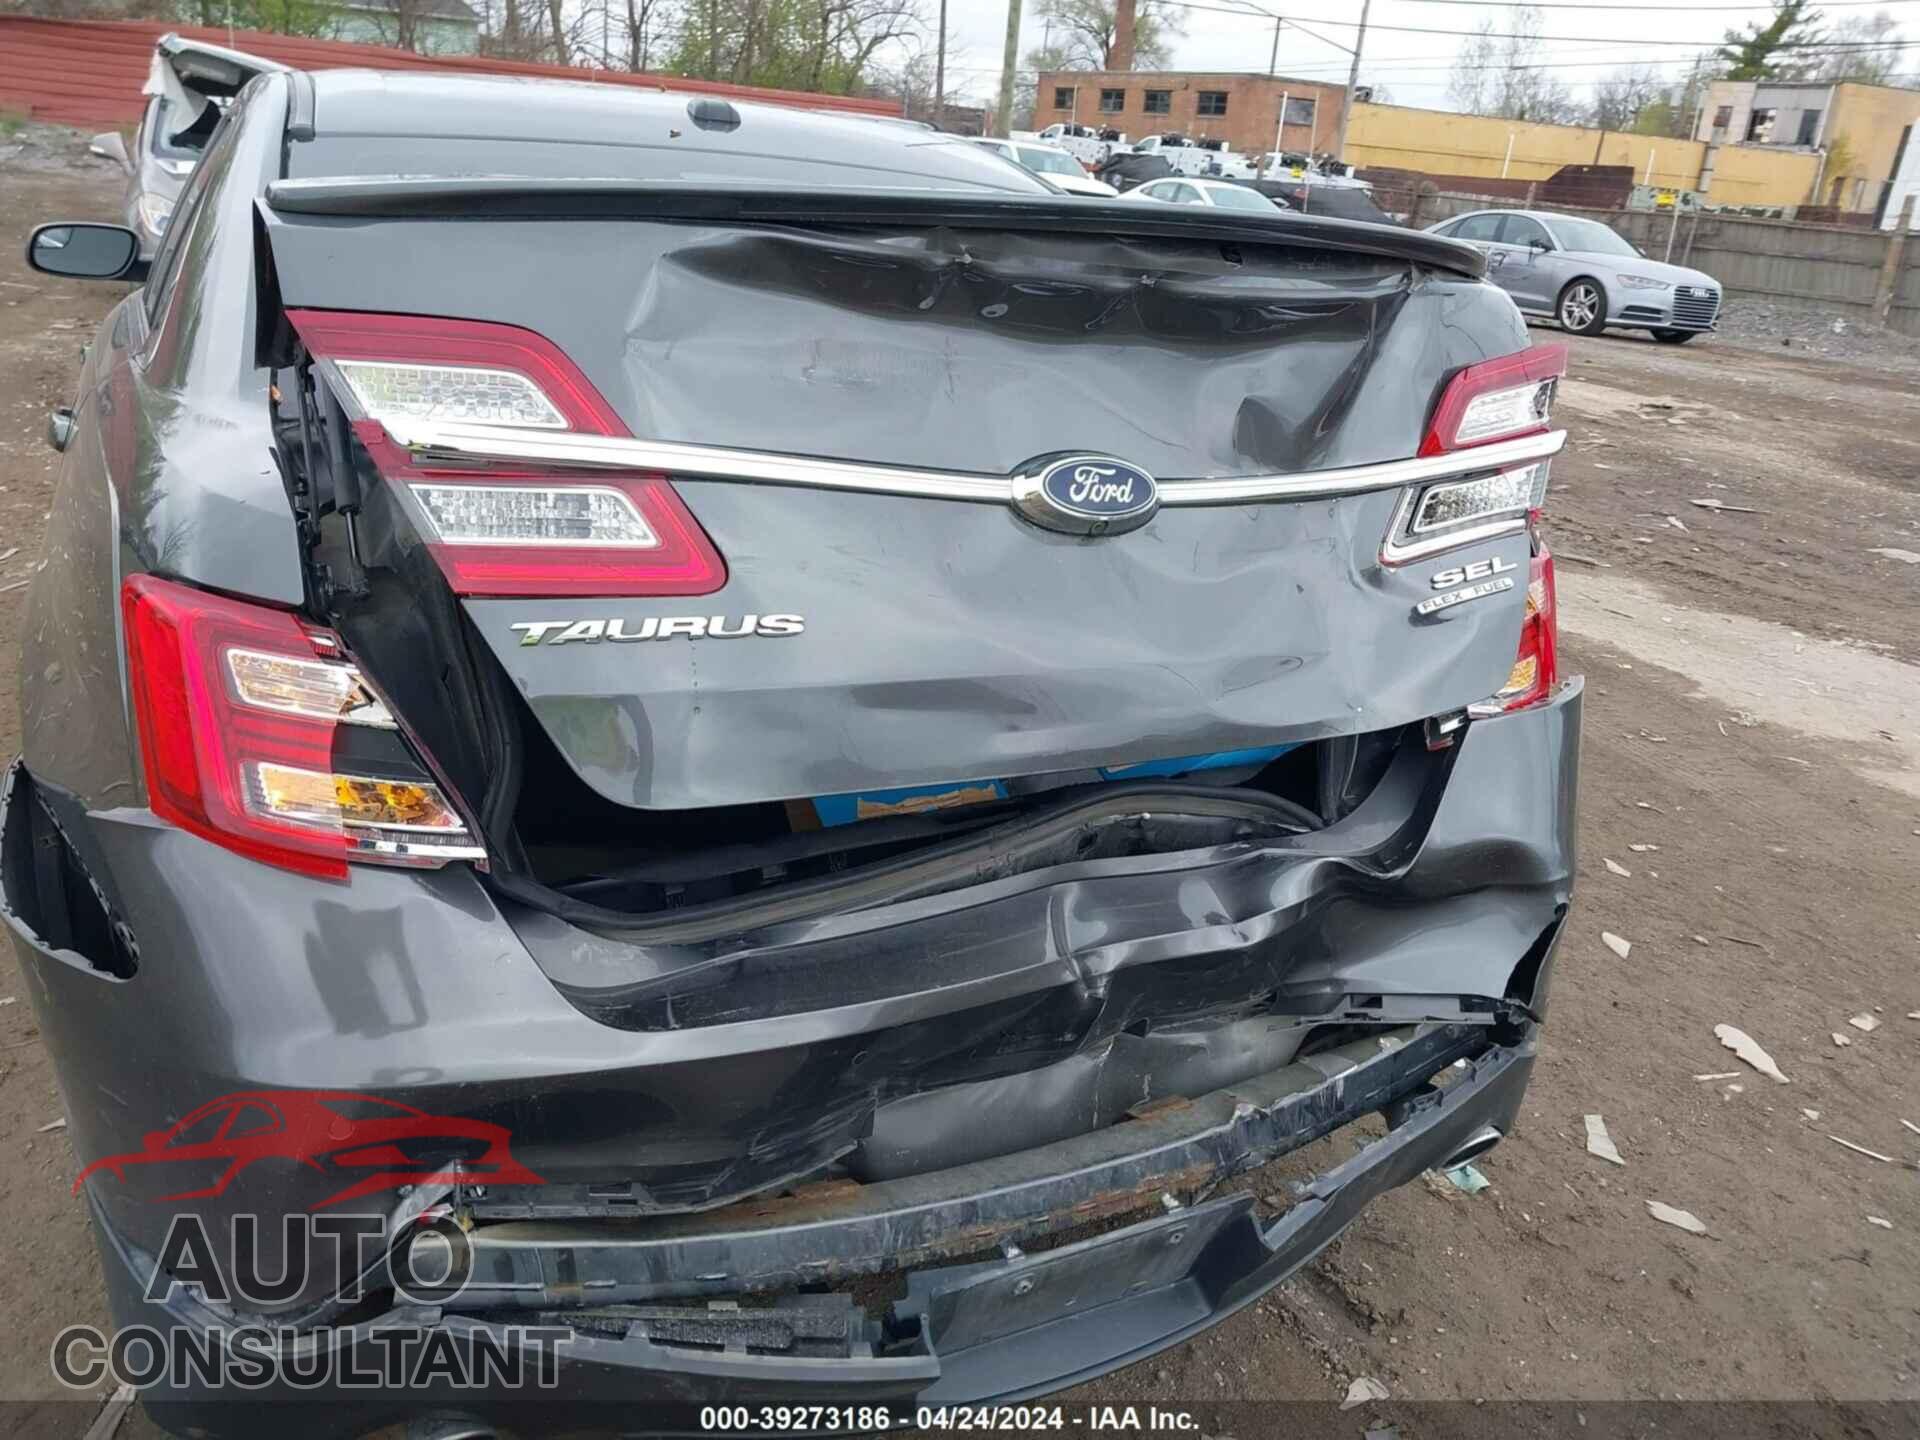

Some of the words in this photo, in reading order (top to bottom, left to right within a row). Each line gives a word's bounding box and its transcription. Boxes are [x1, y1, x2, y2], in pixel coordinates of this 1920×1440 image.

[1070, 466, 1134, 502] Ford
[1431, 556, 1518, 590] SEL
[1421, 591, 1463, 612] FLEX
[1473, 578, 1512, 595] FUEL
[511, 614, 805, 646] TAURUS
